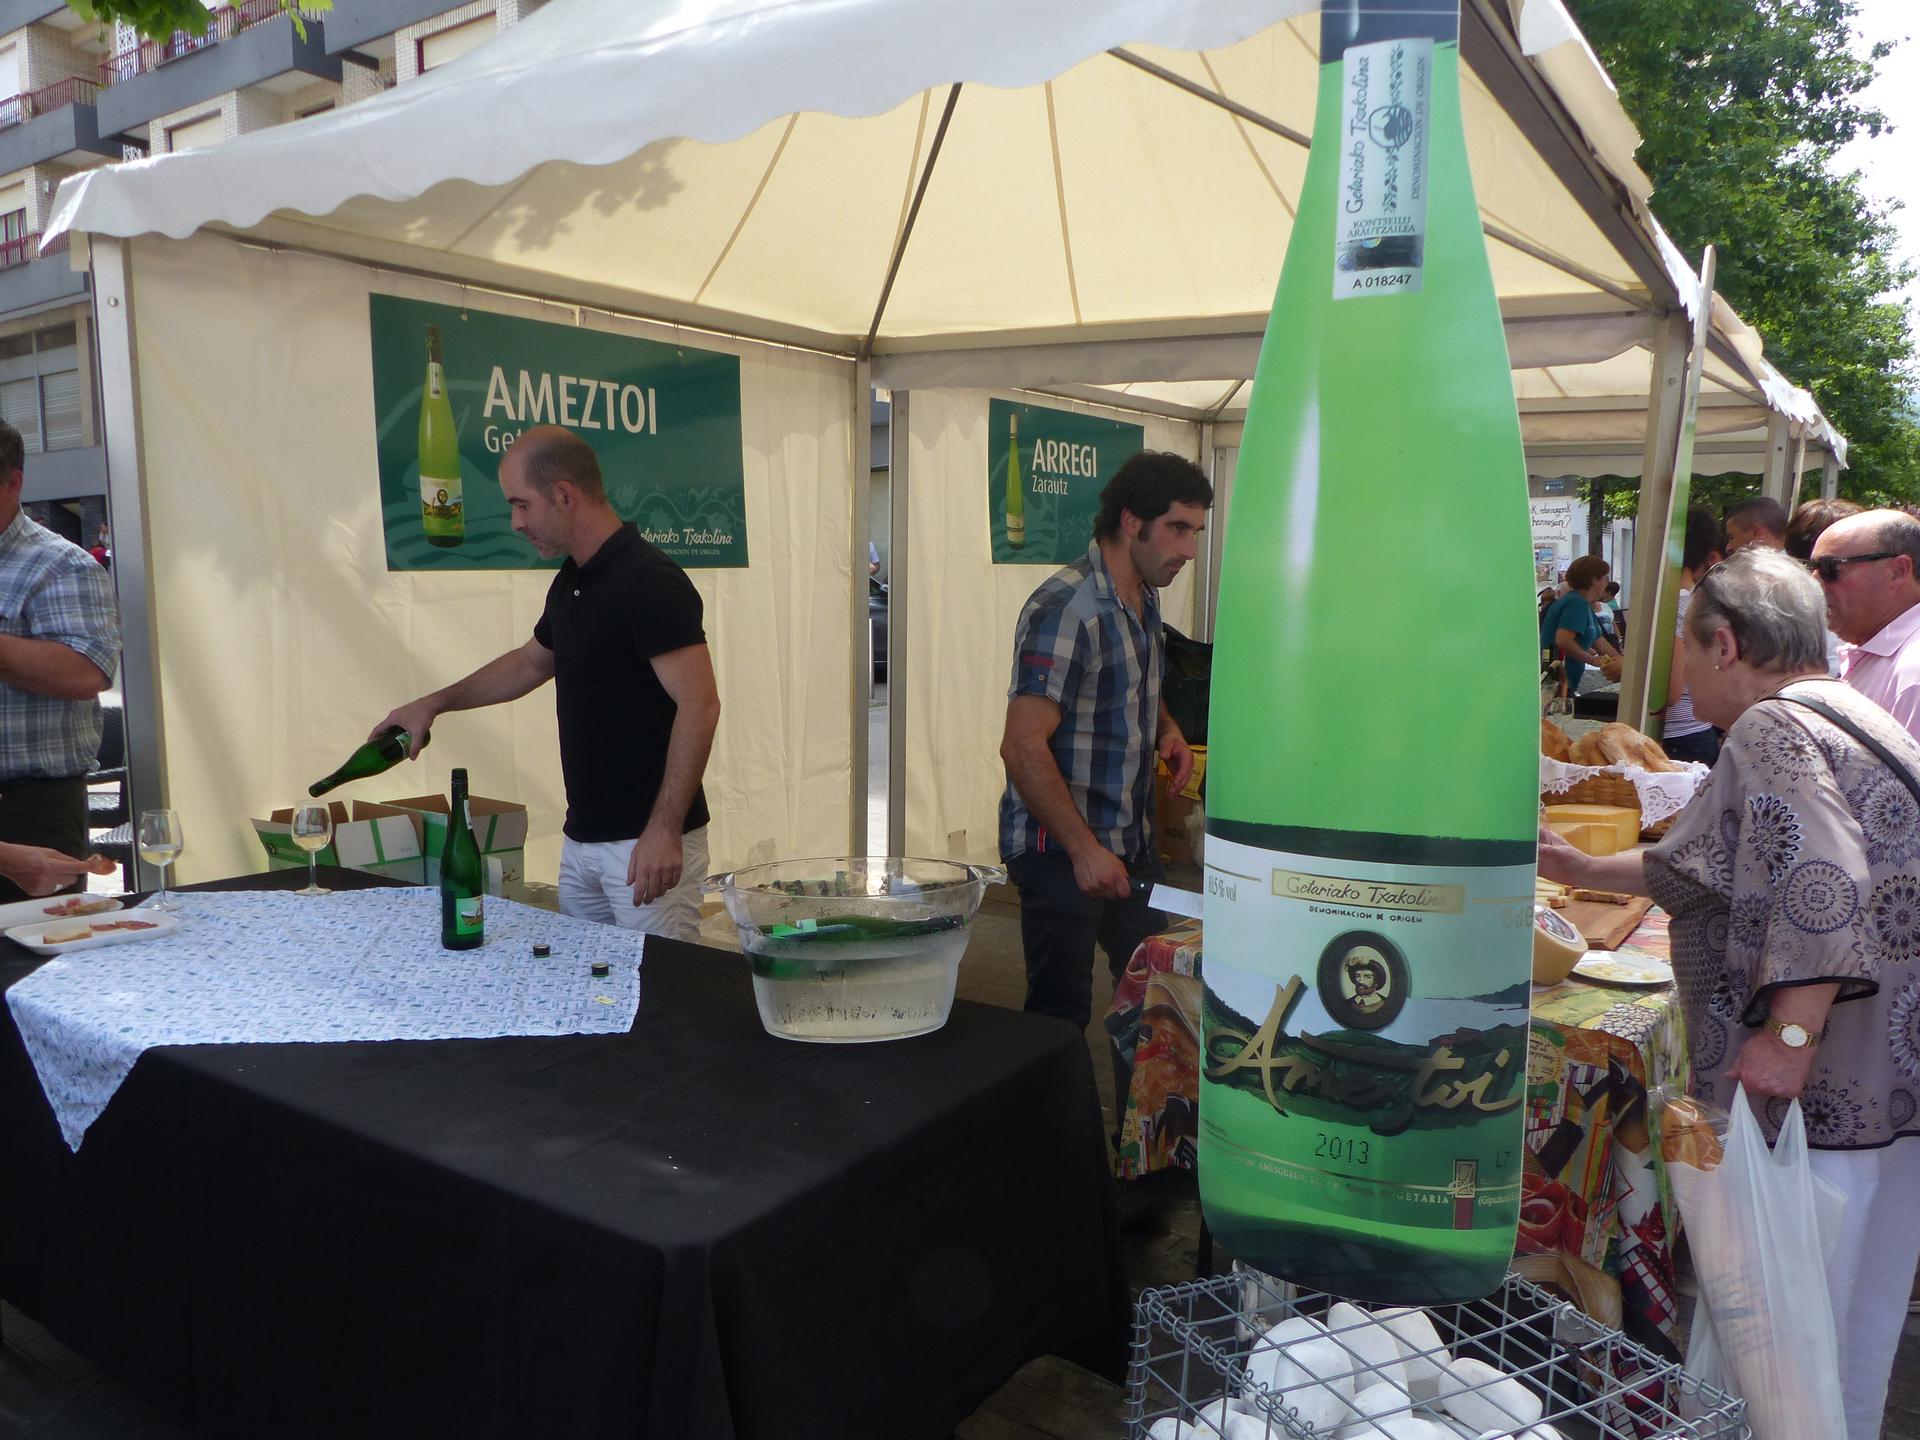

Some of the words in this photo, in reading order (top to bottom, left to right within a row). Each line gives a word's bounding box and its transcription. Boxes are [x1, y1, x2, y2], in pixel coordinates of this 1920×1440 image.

[1349, 56, 1369, 137] Txakolina
[1345, 140, 1365, 214] Getariako
[1347, 224, 1415, 239] ARAUTZAILEA
[1353, 216, 1411, 229] KONTSEILU
[1352, 278, 1363, 289] A
[1365, 274, 1412, 288] 018247
[483, 365, 657, 435] AMEZTOI
[1032, 438, 1097, 478] ARREGI
[1031, 475, 1069, 495] Zarautz
[682, 528, 733, 545] Txakolina
[1286, 876, 1361, 900] Getariako
[1367, 886, 1447, 906] Txakolina
[1309, 905, 1372, 920] DENOMINACION
[1376, 913, 1385, 921] DE
[1389, 915, 1423, 924] ORIGEN
[1314, 1133, 1369, 1165] 2013
[1397, 1191, 1450, 1205] GETARIA
